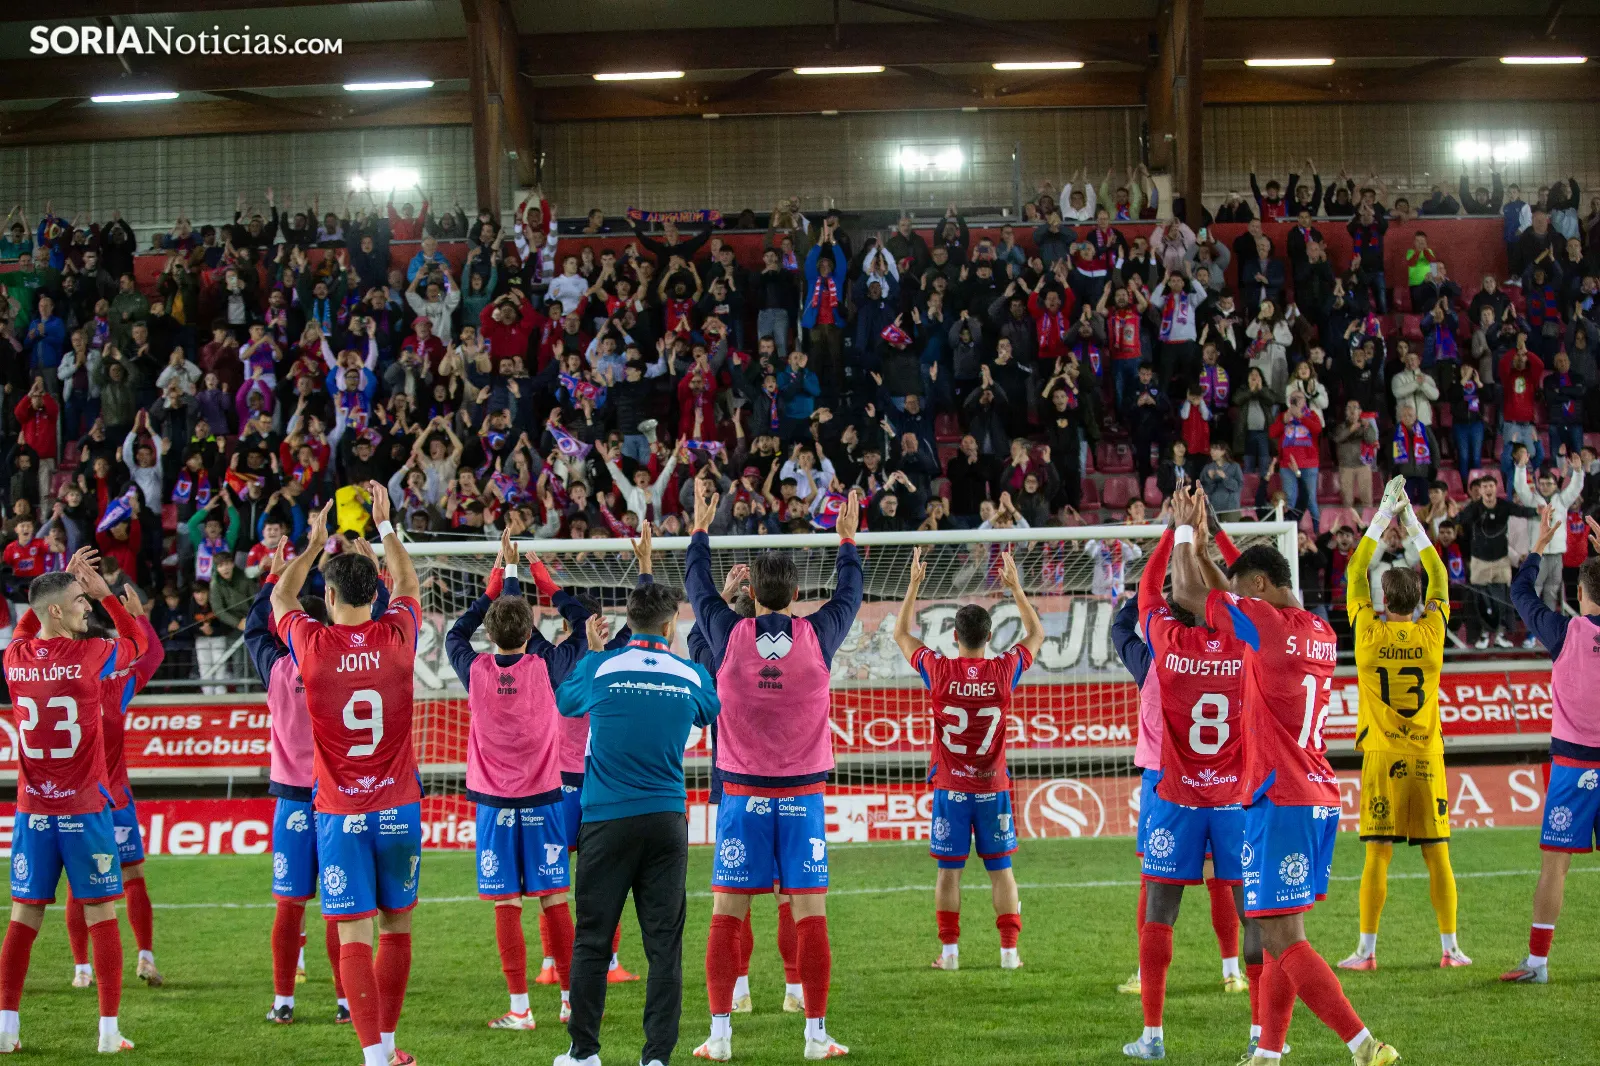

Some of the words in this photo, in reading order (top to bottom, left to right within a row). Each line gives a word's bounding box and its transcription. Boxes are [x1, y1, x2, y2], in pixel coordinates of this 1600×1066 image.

[1378, 643, 1423, 660] SÚNICO
[336, 650, 380, 673] JONY
[42, 662, 83, 681] LÓPEZ
[949, 681, 997, 697] FLORES
[1375, 666, 1426, 718] 13
[1455, 684, 1552, 703] PLATA
[17, 695, 82, 759] 23
[342, 689, 384, 757] 9
[940, 705, 1002, 756] 27
[1188, 693, 1230, 755] 8
[1213, 774, 1238, 785] Soria
[89, 873, 118, 885] Soria
[537, 864, 565, 876] Soria
